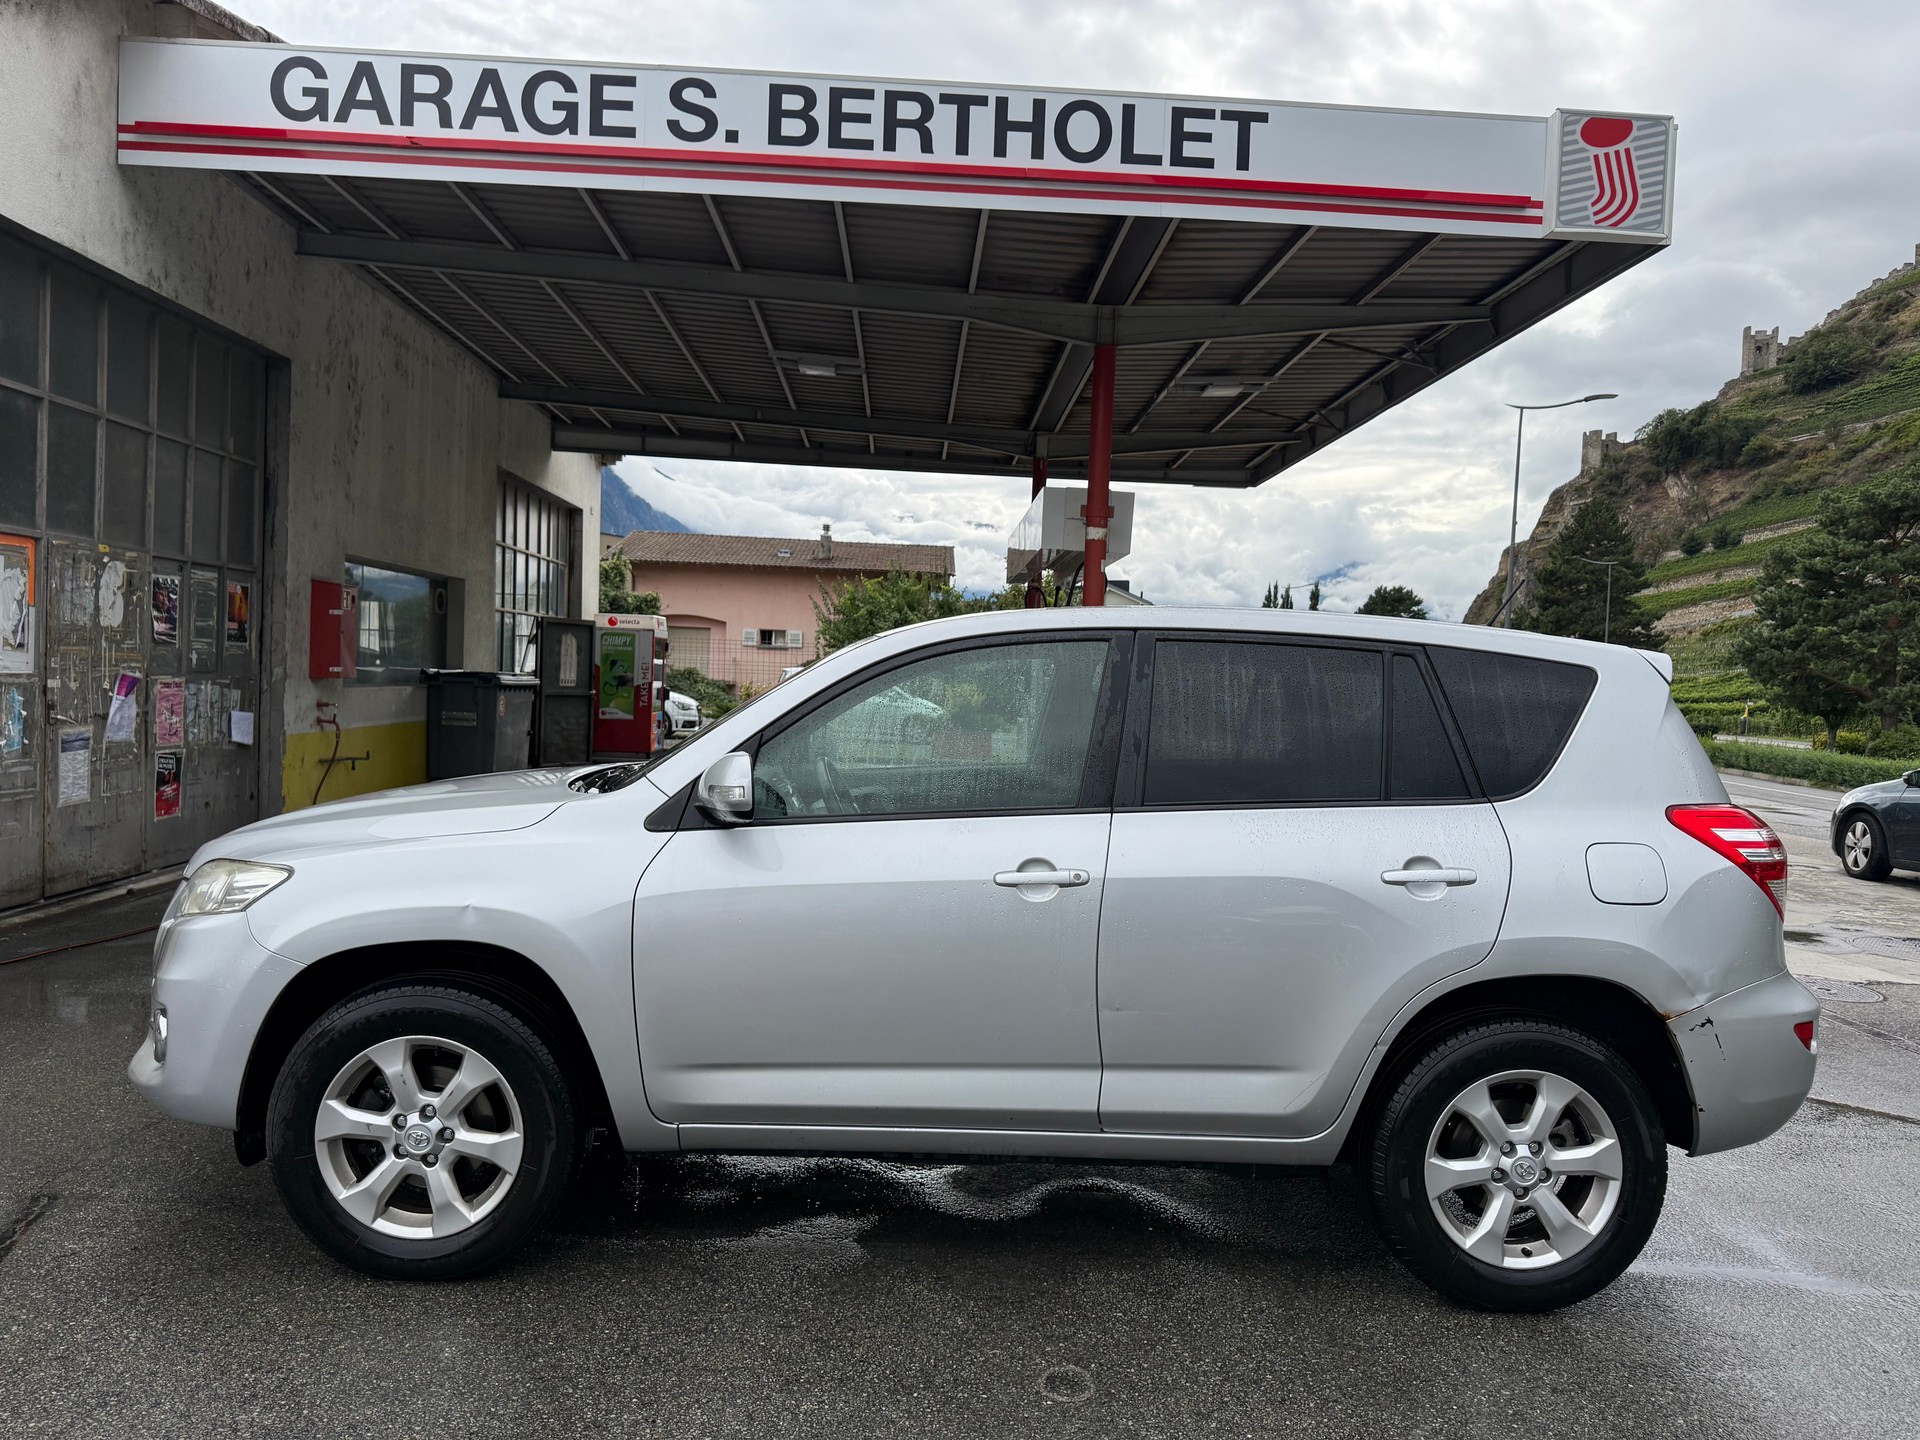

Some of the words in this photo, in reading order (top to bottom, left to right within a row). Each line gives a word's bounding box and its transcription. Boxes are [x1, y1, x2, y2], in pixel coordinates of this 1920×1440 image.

[270, 56, 638, 139] GARAGE
[666, 77, 740, 144] S.
[767, 82, 1270, 172] BERTHOLET
[602, 635, 631, 646] CHIMPY
[641, 661, 650, 681] ME!
[640, 682, 650, 708] TAKE
